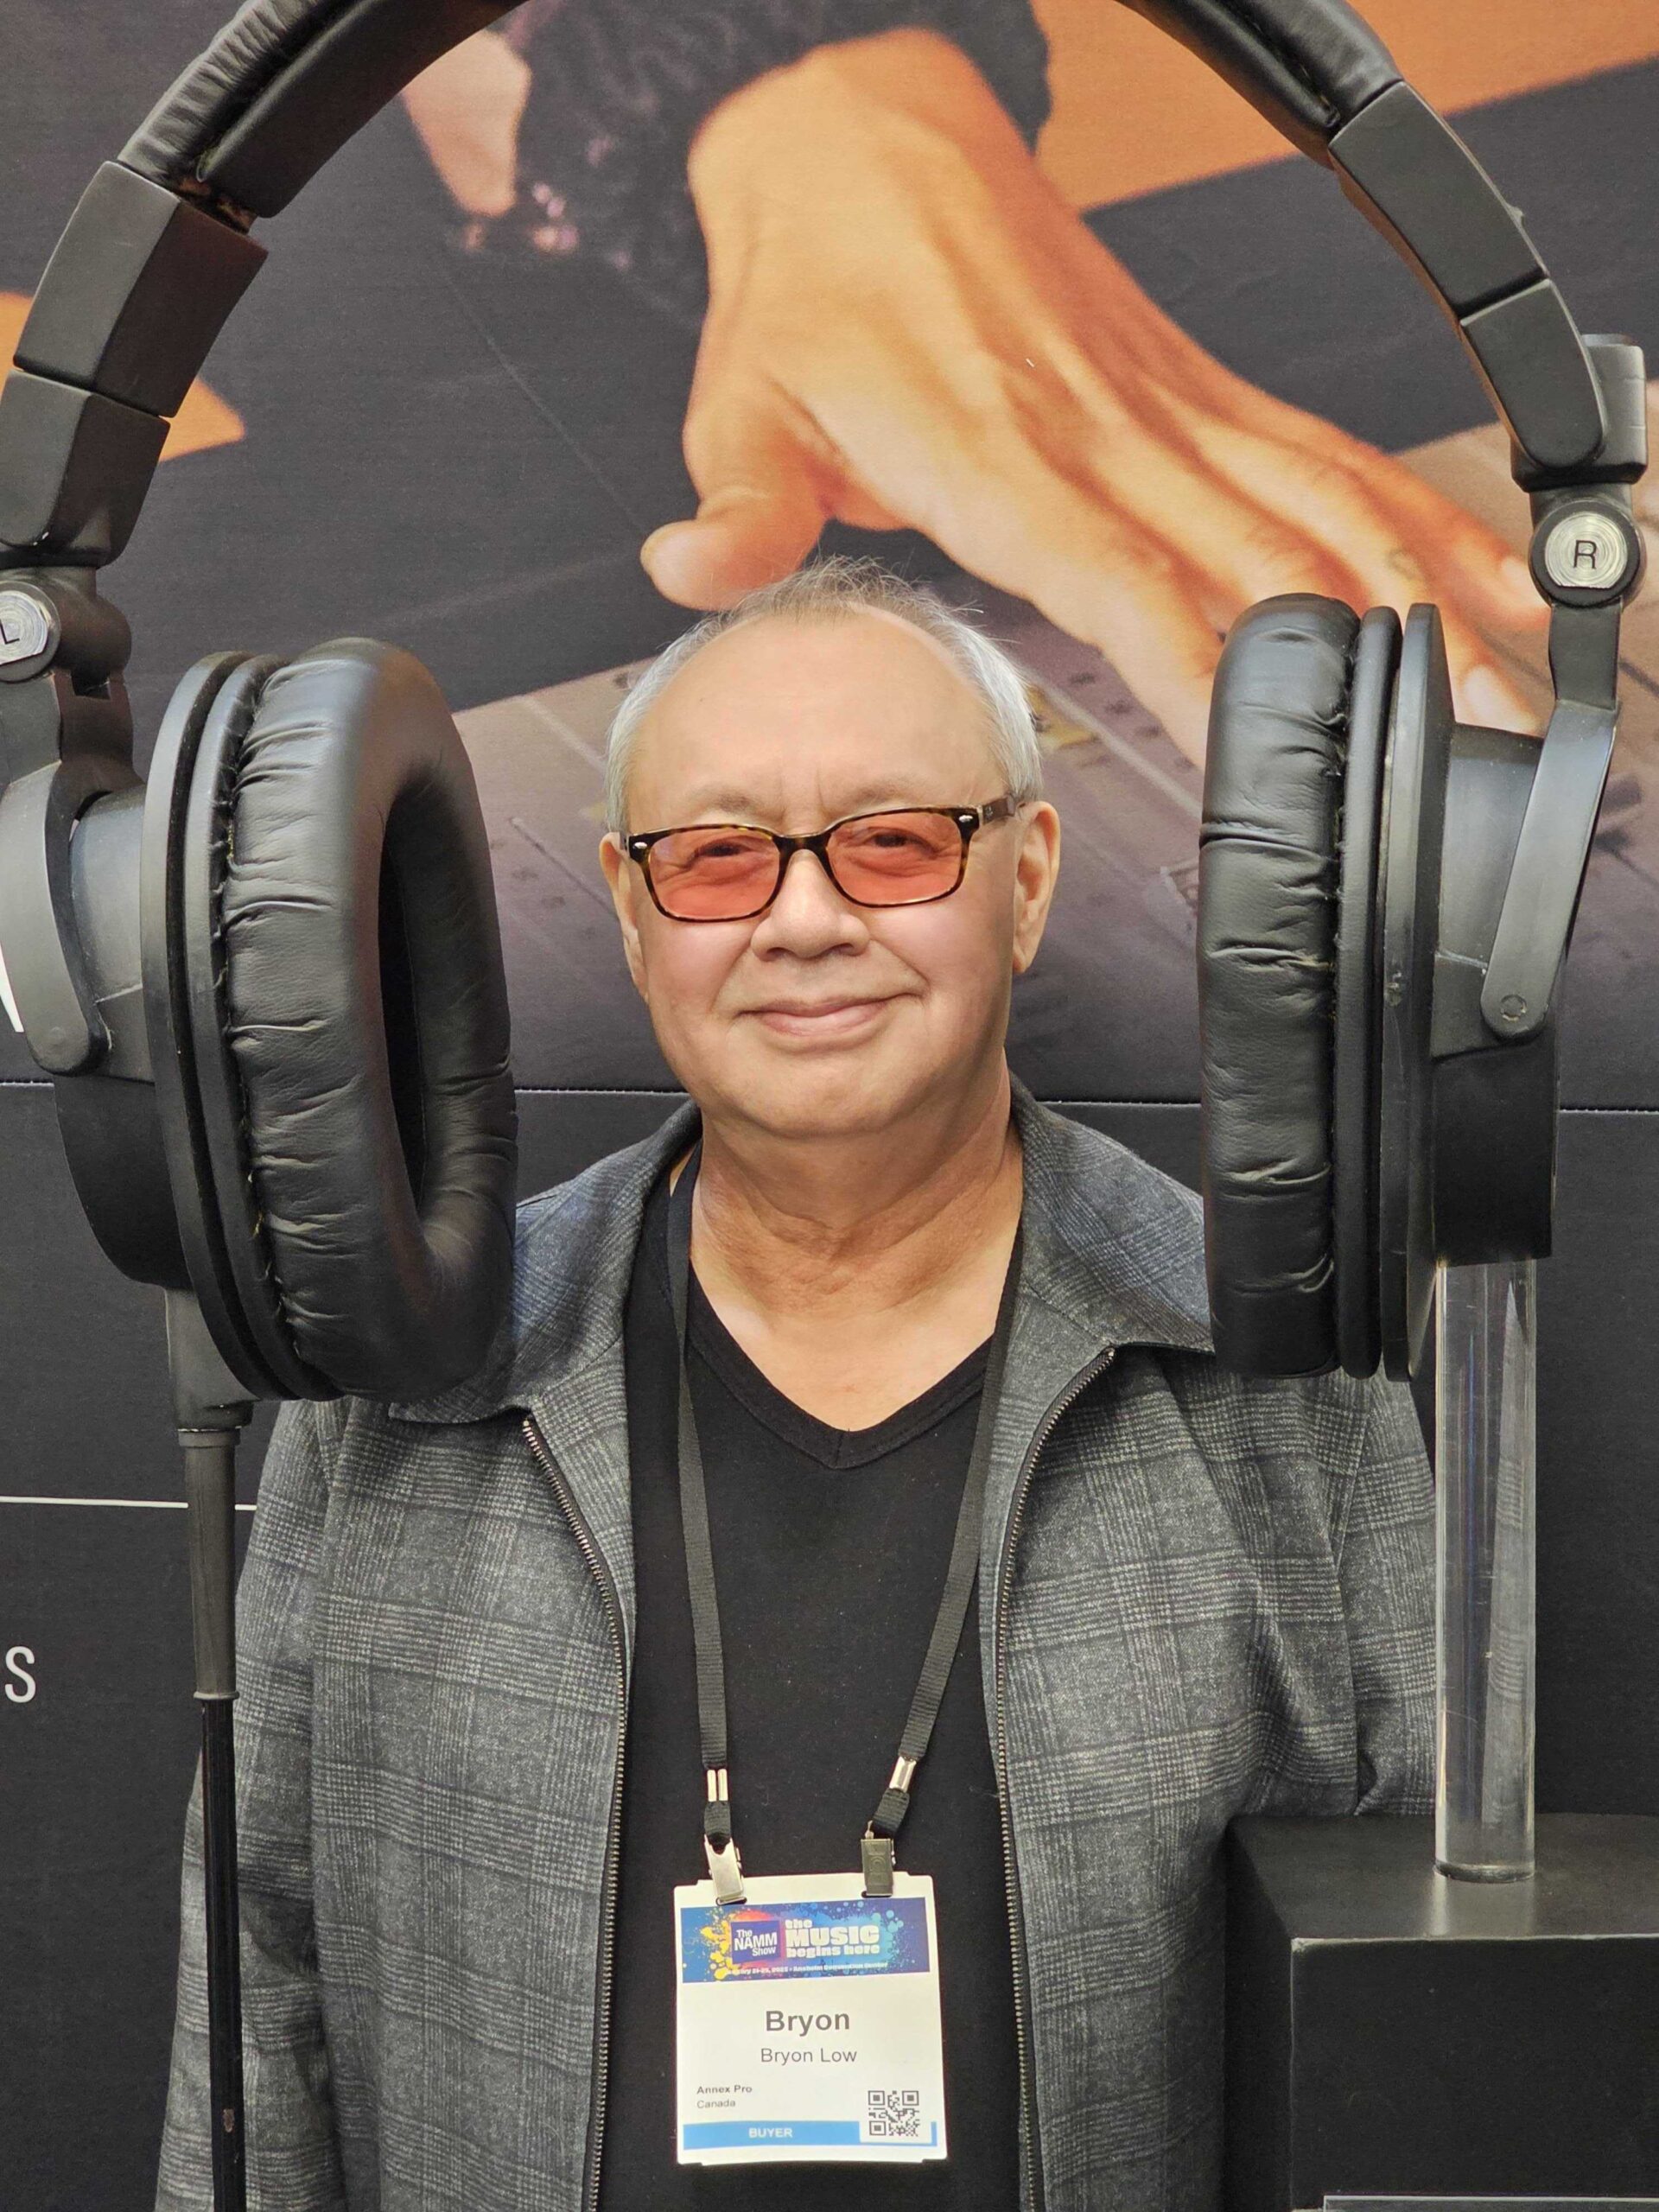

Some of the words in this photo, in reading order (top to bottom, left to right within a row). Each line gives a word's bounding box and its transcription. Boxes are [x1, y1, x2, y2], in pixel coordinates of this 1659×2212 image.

[1573, 539, 1598, 569] R
[0, 619, 20, 645] L
[4, 1646, 36, 1703] S
[785, 1919, 812, 1929] the
[734, 1932, 778, 1951] NAMM
[737, 1929, 753, 1938] The
[786, 1925, 880, 1947] MUSIC
[752, 1946, 776, 1956] Show
[785, 1946, 841, 1959] begins
[844, 1945, 880, 1955] here
[766, 2010, 850, 2037] Bryon
[760, 2048, 813, 2066] Bryon
[821, 2048, 857, 2063] Low
[696, 2085, 731, 2094] Annex
[734, 2084, 753, 2094] Pro
[696, 2099, 736, 2109] Canada
[748, 2127, 793, 2139] BUYER
